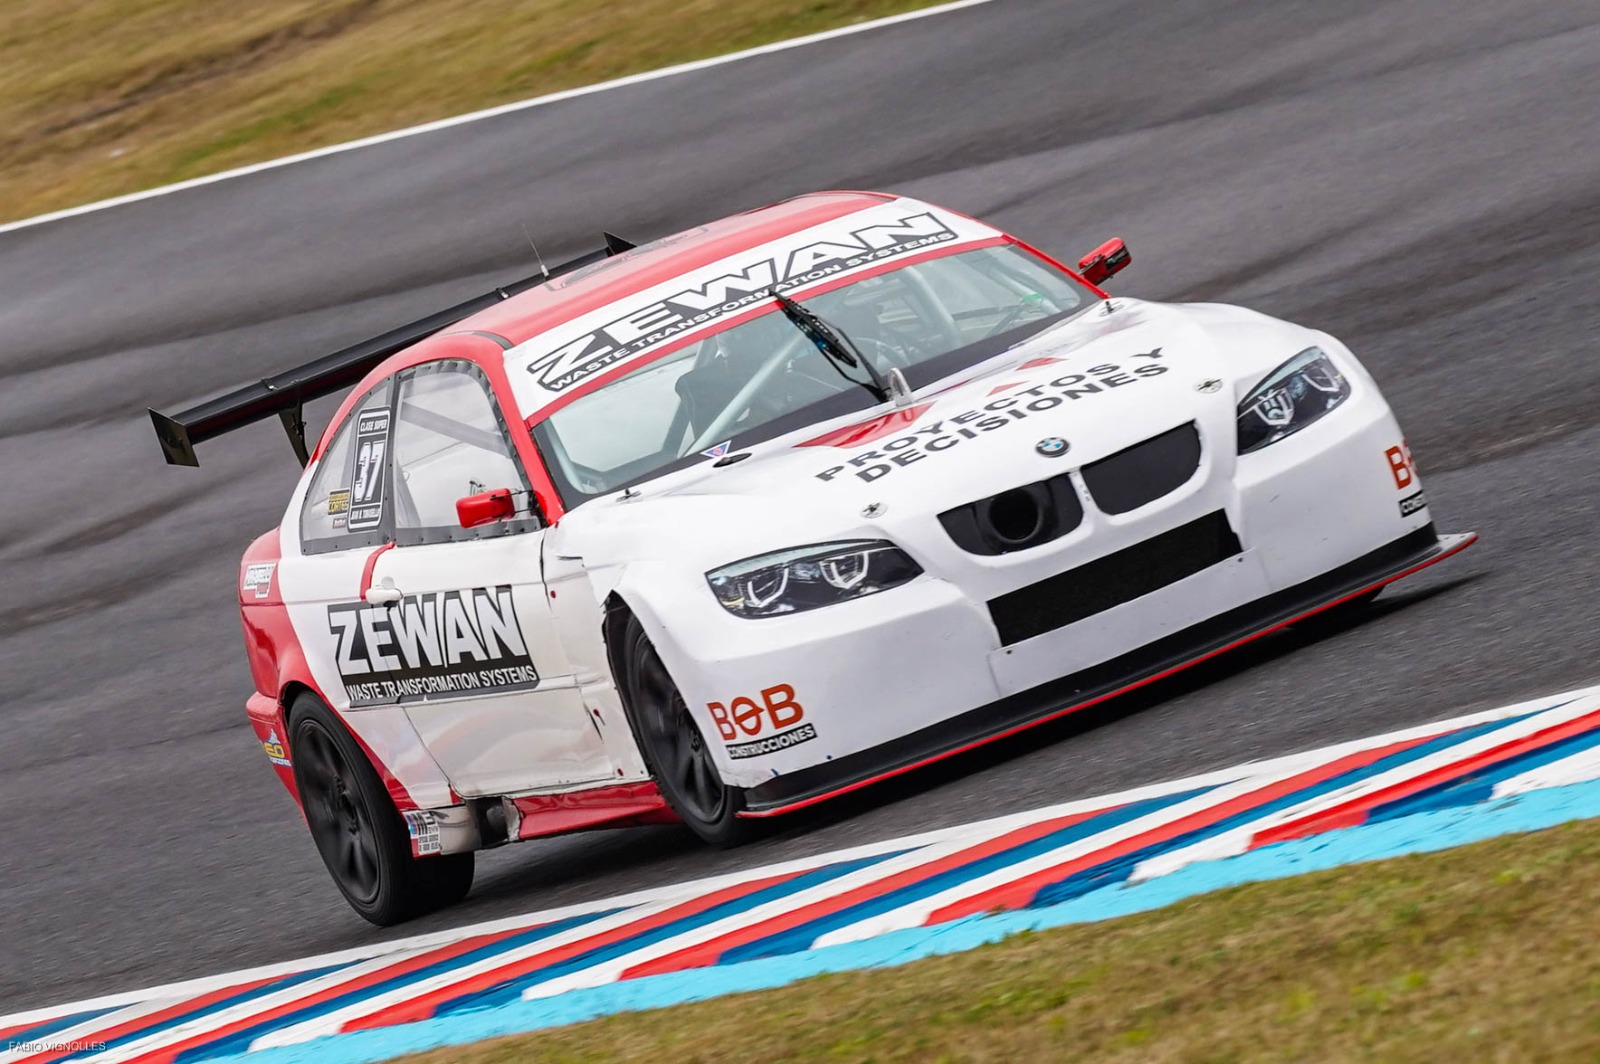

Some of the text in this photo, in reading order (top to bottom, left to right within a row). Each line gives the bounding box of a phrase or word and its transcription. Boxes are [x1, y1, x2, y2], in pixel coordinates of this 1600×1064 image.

[528, 212, 949, 386] ZEWAN
[550, 232, 954, 390] WASTE TRANSFORMATION SYSTEMS
[815, 347, 1165, 482] PROYECTOS Y
[856, 363, 1170, 483] DECISIONES
[354, 441, 385, 502] 37
[329, 591, 528, 676] ZEWAN
[346, 665, 538, 701] WASTE TRANSFORMATION SYSTEMS
[728, 725, 815, 758] CONSTRUCCIONES
